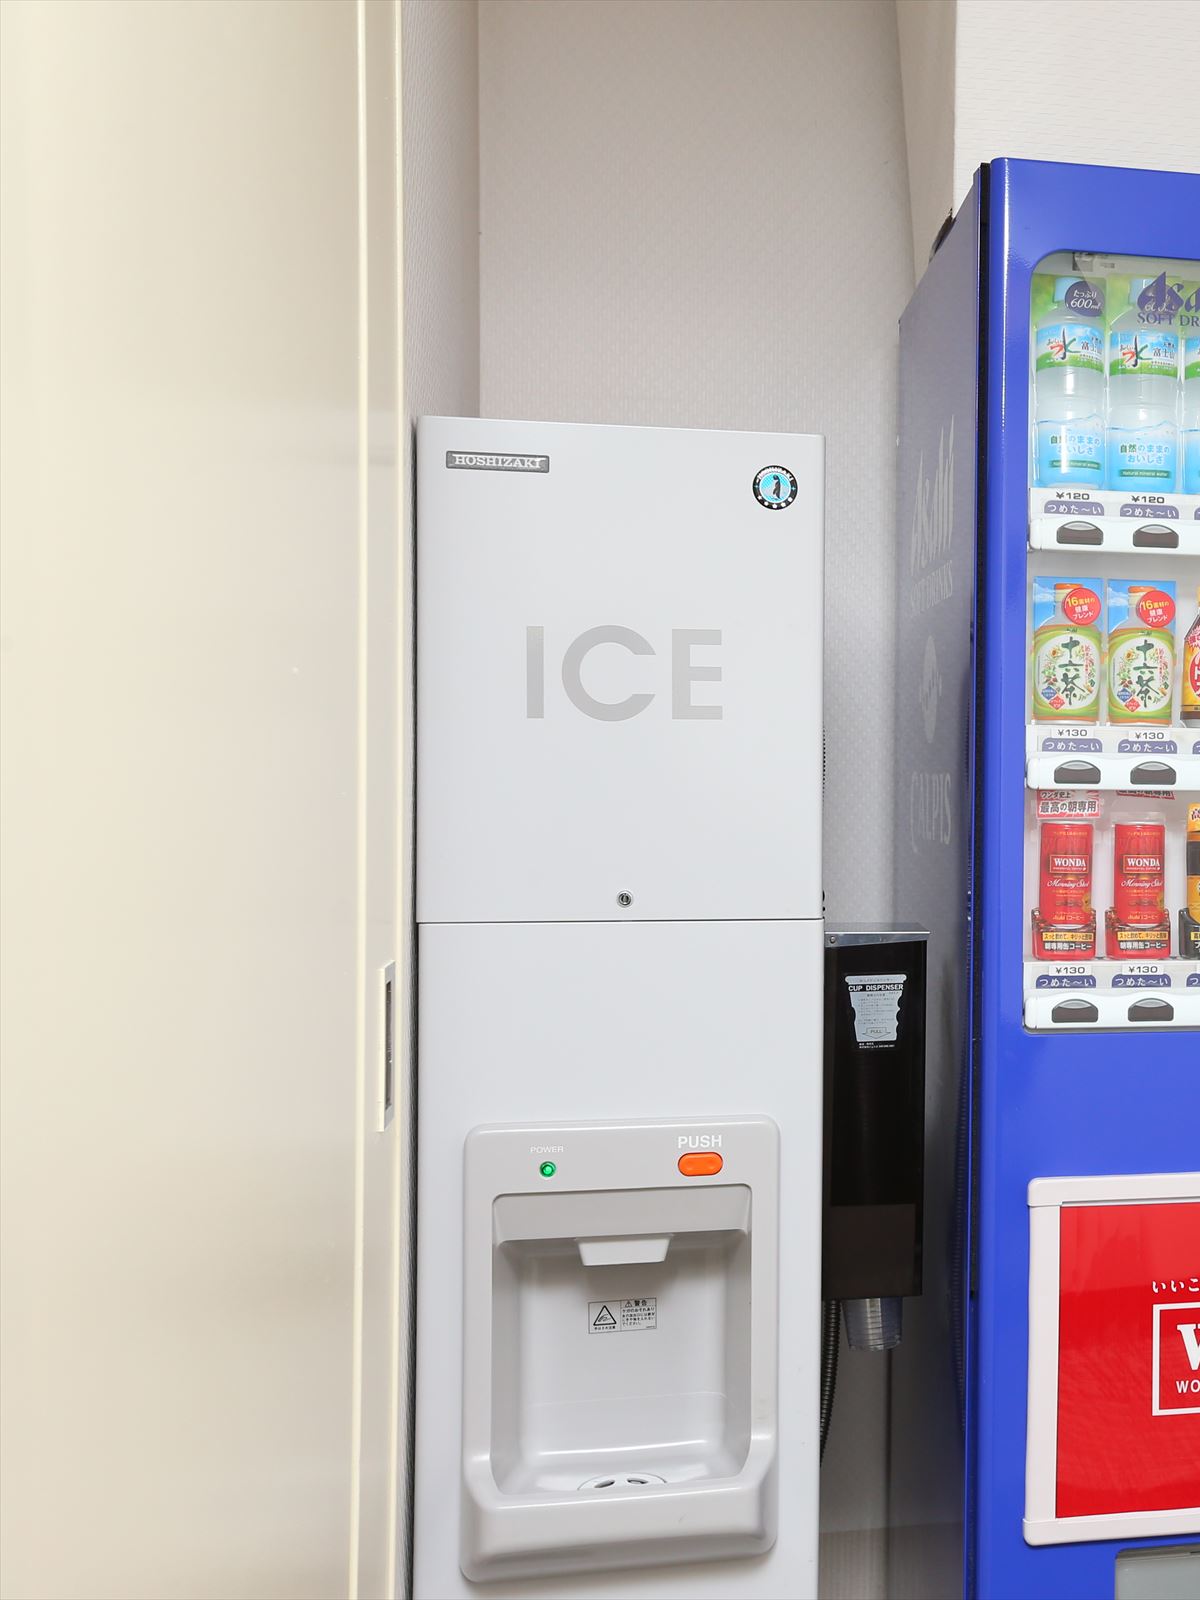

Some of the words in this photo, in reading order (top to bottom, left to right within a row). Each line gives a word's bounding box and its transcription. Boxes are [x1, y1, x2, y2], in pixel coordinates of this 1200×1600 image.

[1073, 290, 1097, 299] たっぷり
[1070, 298, 1101, 310] 600ml
[1137, 312, 1174, 325] SOFT
[1051, 435, 1099, 444] 自のままの
[1120, 444, 1170, 453] 自然のままの
[454, 455, 542, 469] HOSHIZAKI
[1128, 456, 1163, 464] おいしさ
[1055, 492, 1090, 500] ¥120
[1131, 495, 1165, 504] ¥120
[526, 625, 723, 722] ICE
[1058, 636, 1086, 706] 十六茶
[1133, 639, 1160, 708] 十六茶
[1058, 729, 1087, 737] ¥130
[1135, 732, 1165, 740] ¥130
[1040, 801, 1097, 813] 最高の朝専用
[910, 772, 952, 853] CALPIS
[1054, 858, 1086, 867] WONDA
[1127, 858, 1160, 867] WONDA
[1047, 879, 1076, 888] Morning
[1121, 879, 1150, 888] Morning
[1055, 966, 1085, 974] ¥130
[678, 1135, 722, 1148] PUSH
[530, 1145, 564, 1153] POWER
